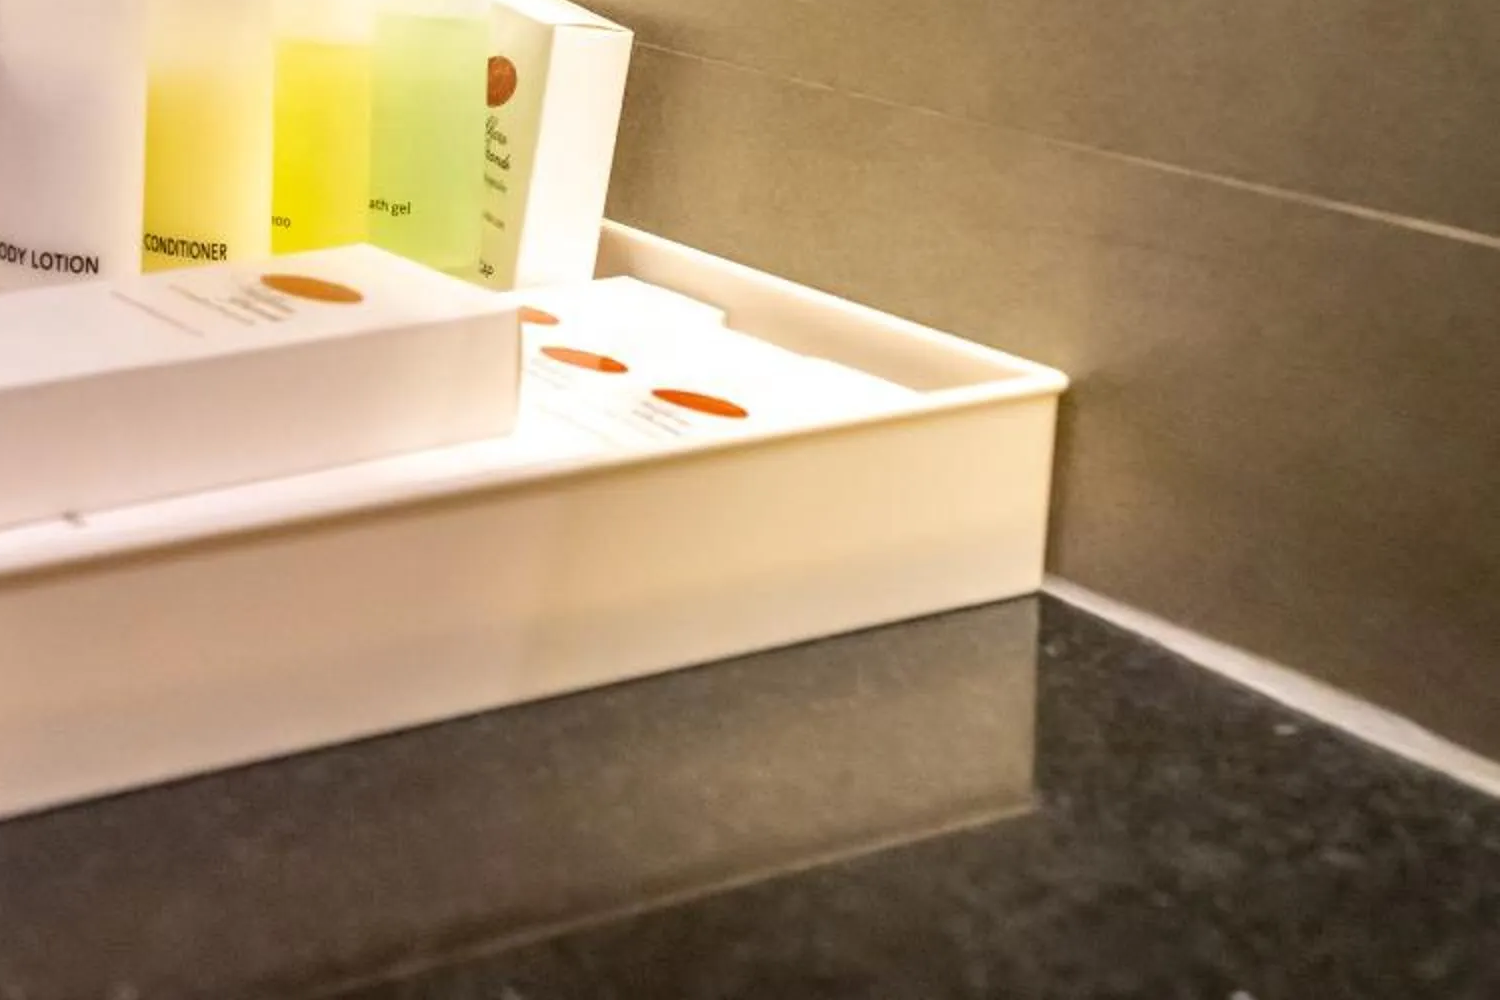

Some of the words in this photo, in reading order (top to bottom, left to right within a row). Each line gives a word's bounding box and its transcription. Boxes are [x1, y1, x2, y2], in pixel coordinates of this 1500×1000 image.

[368, 198, 389, 212] ath
[391, 201, 411, 217] gel
[143, 233, 228, 261] CONDITIONER
[31, 249, 100, 275] LOTION
